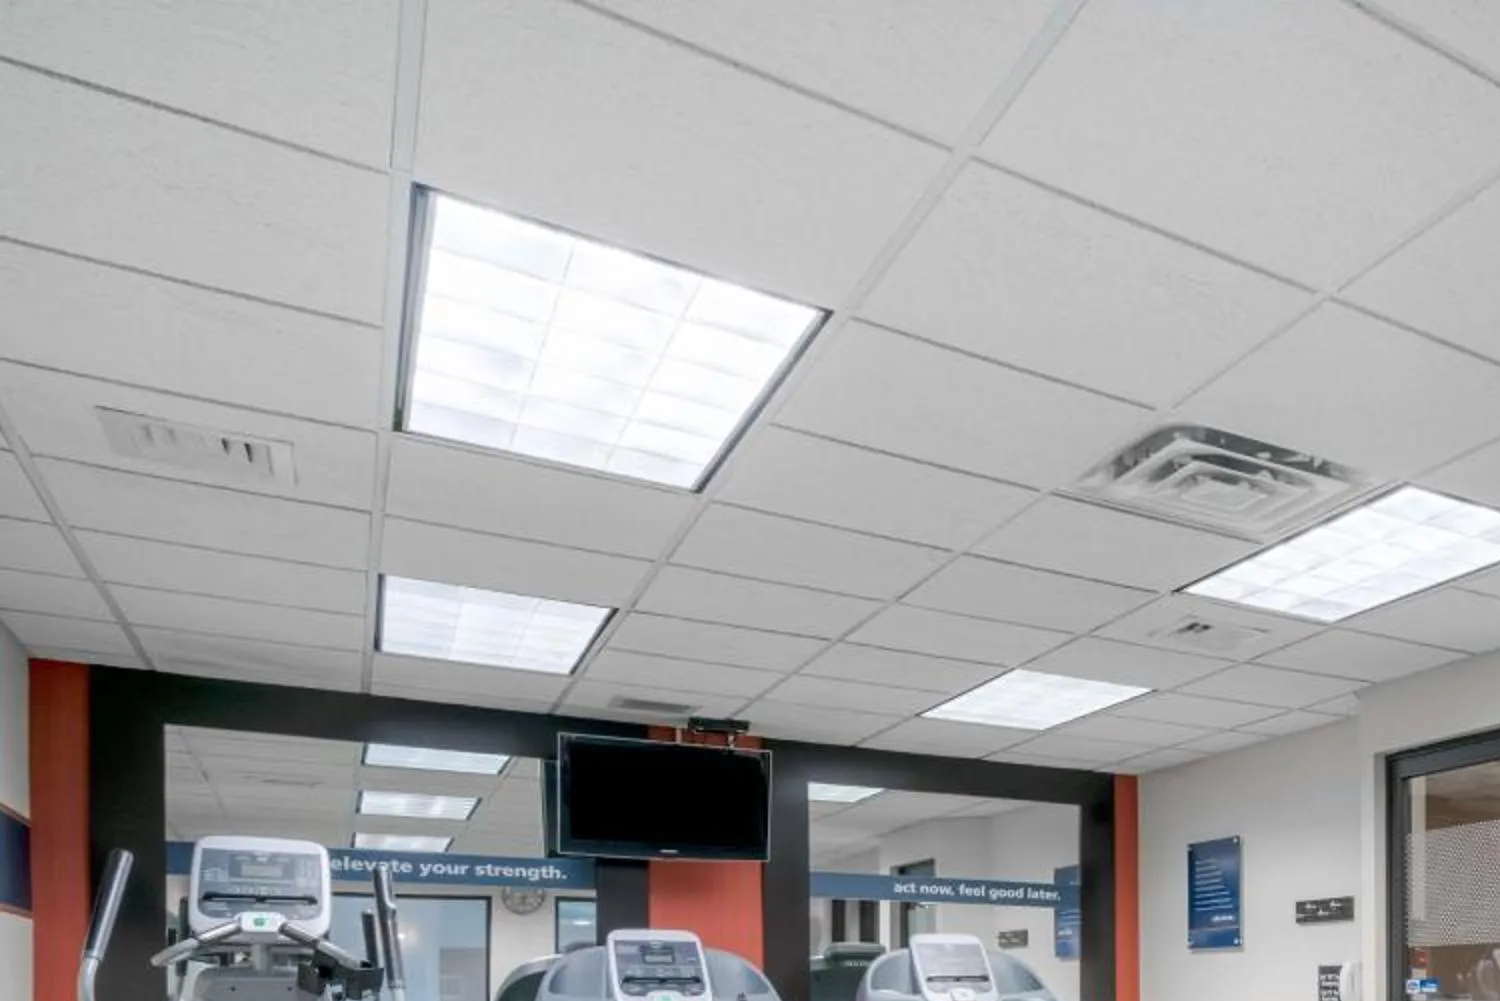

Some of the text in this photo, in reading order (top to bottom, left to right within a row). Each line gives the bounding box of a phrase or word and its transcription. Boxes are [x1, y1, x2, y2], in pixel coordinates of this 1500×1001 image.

[419, 861, 469, 877] your
[475, 864, 568, 881] strength.
[894, 882, 917, 894] act
[959, 885, 986, 897] feel
[988, 886, 1025, 900] good
